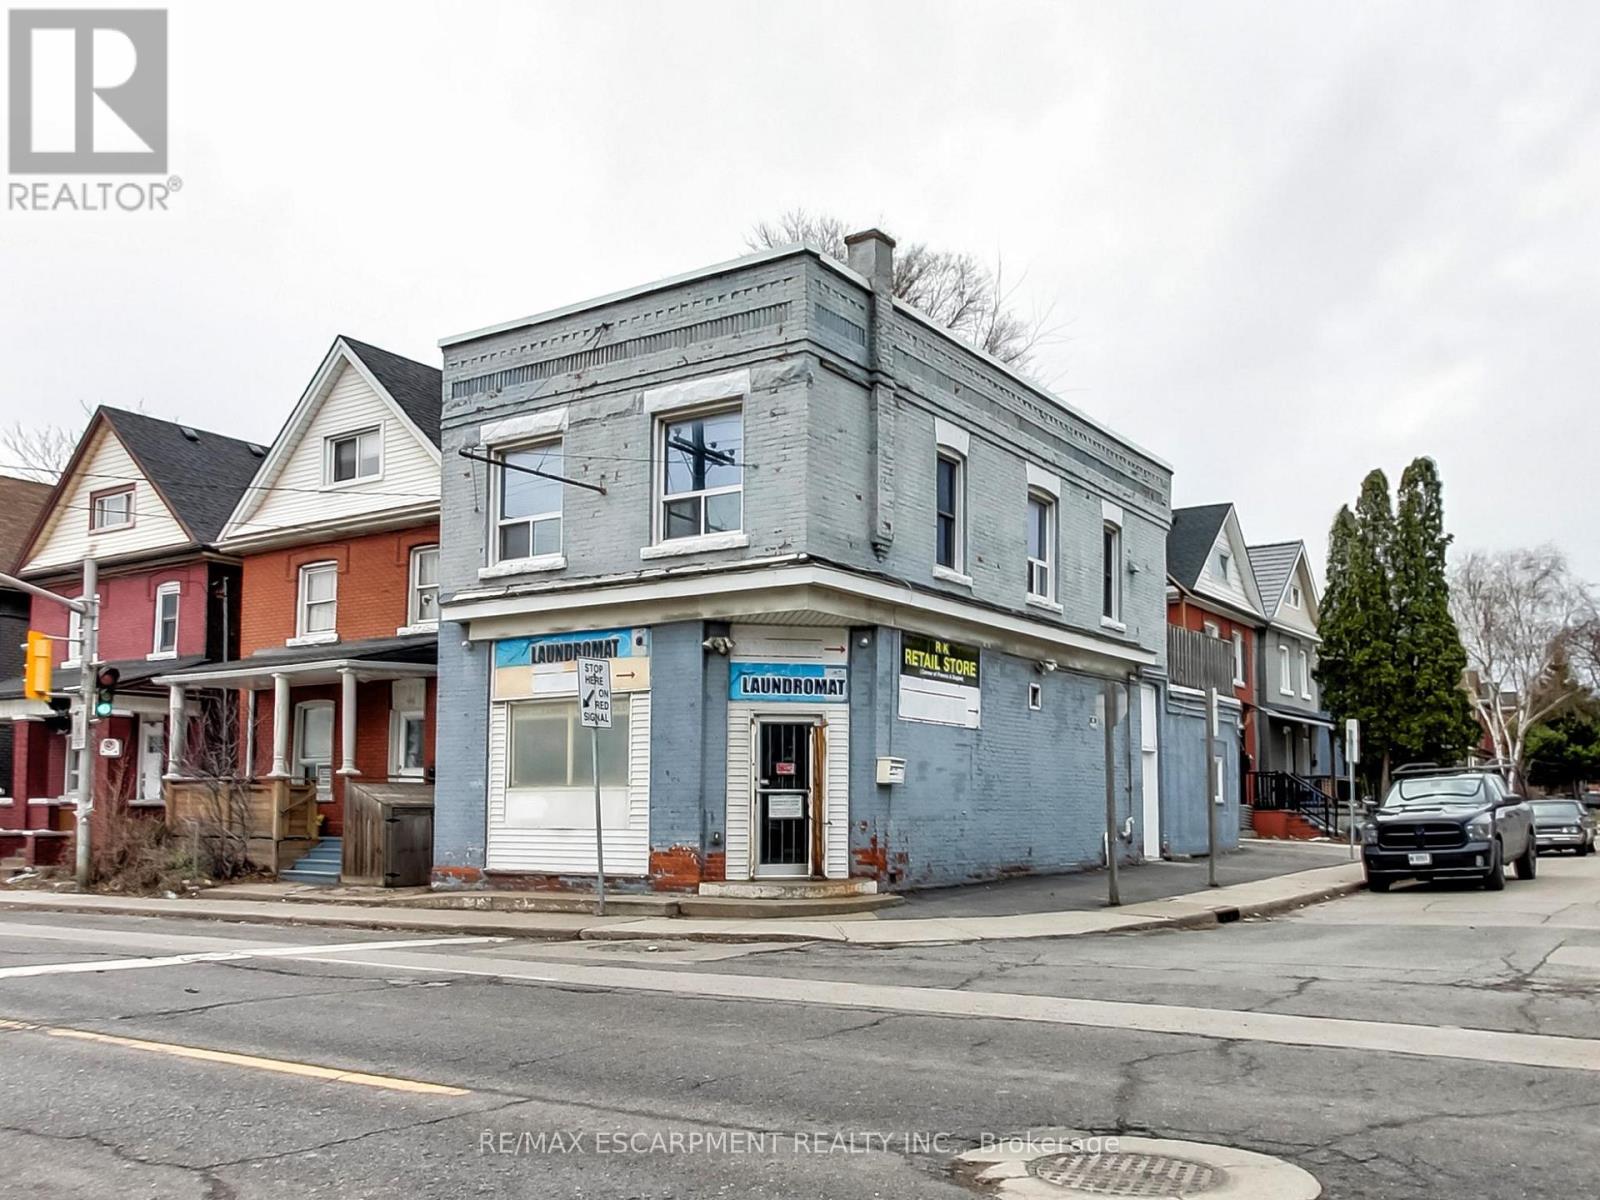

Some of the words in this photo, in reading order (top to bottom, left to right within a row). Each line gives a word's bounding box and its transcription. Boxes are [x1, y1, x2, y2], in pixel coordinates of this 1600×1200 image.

[531, 638, 620, 664] LAUNDROMAT
[584, 662, 604, 673] STOP
[904, 647, 941, 671] RETAIL
[943, 656, 977, 678] STORE
[584, 675, 604, 686] HERE
[741, 676, 846, 695] LAUNDROMAT
[598, 689, 609, 698] ON
[595, 700, 610, 710] RED
[583, 711, 609, 722] SIGNAL
